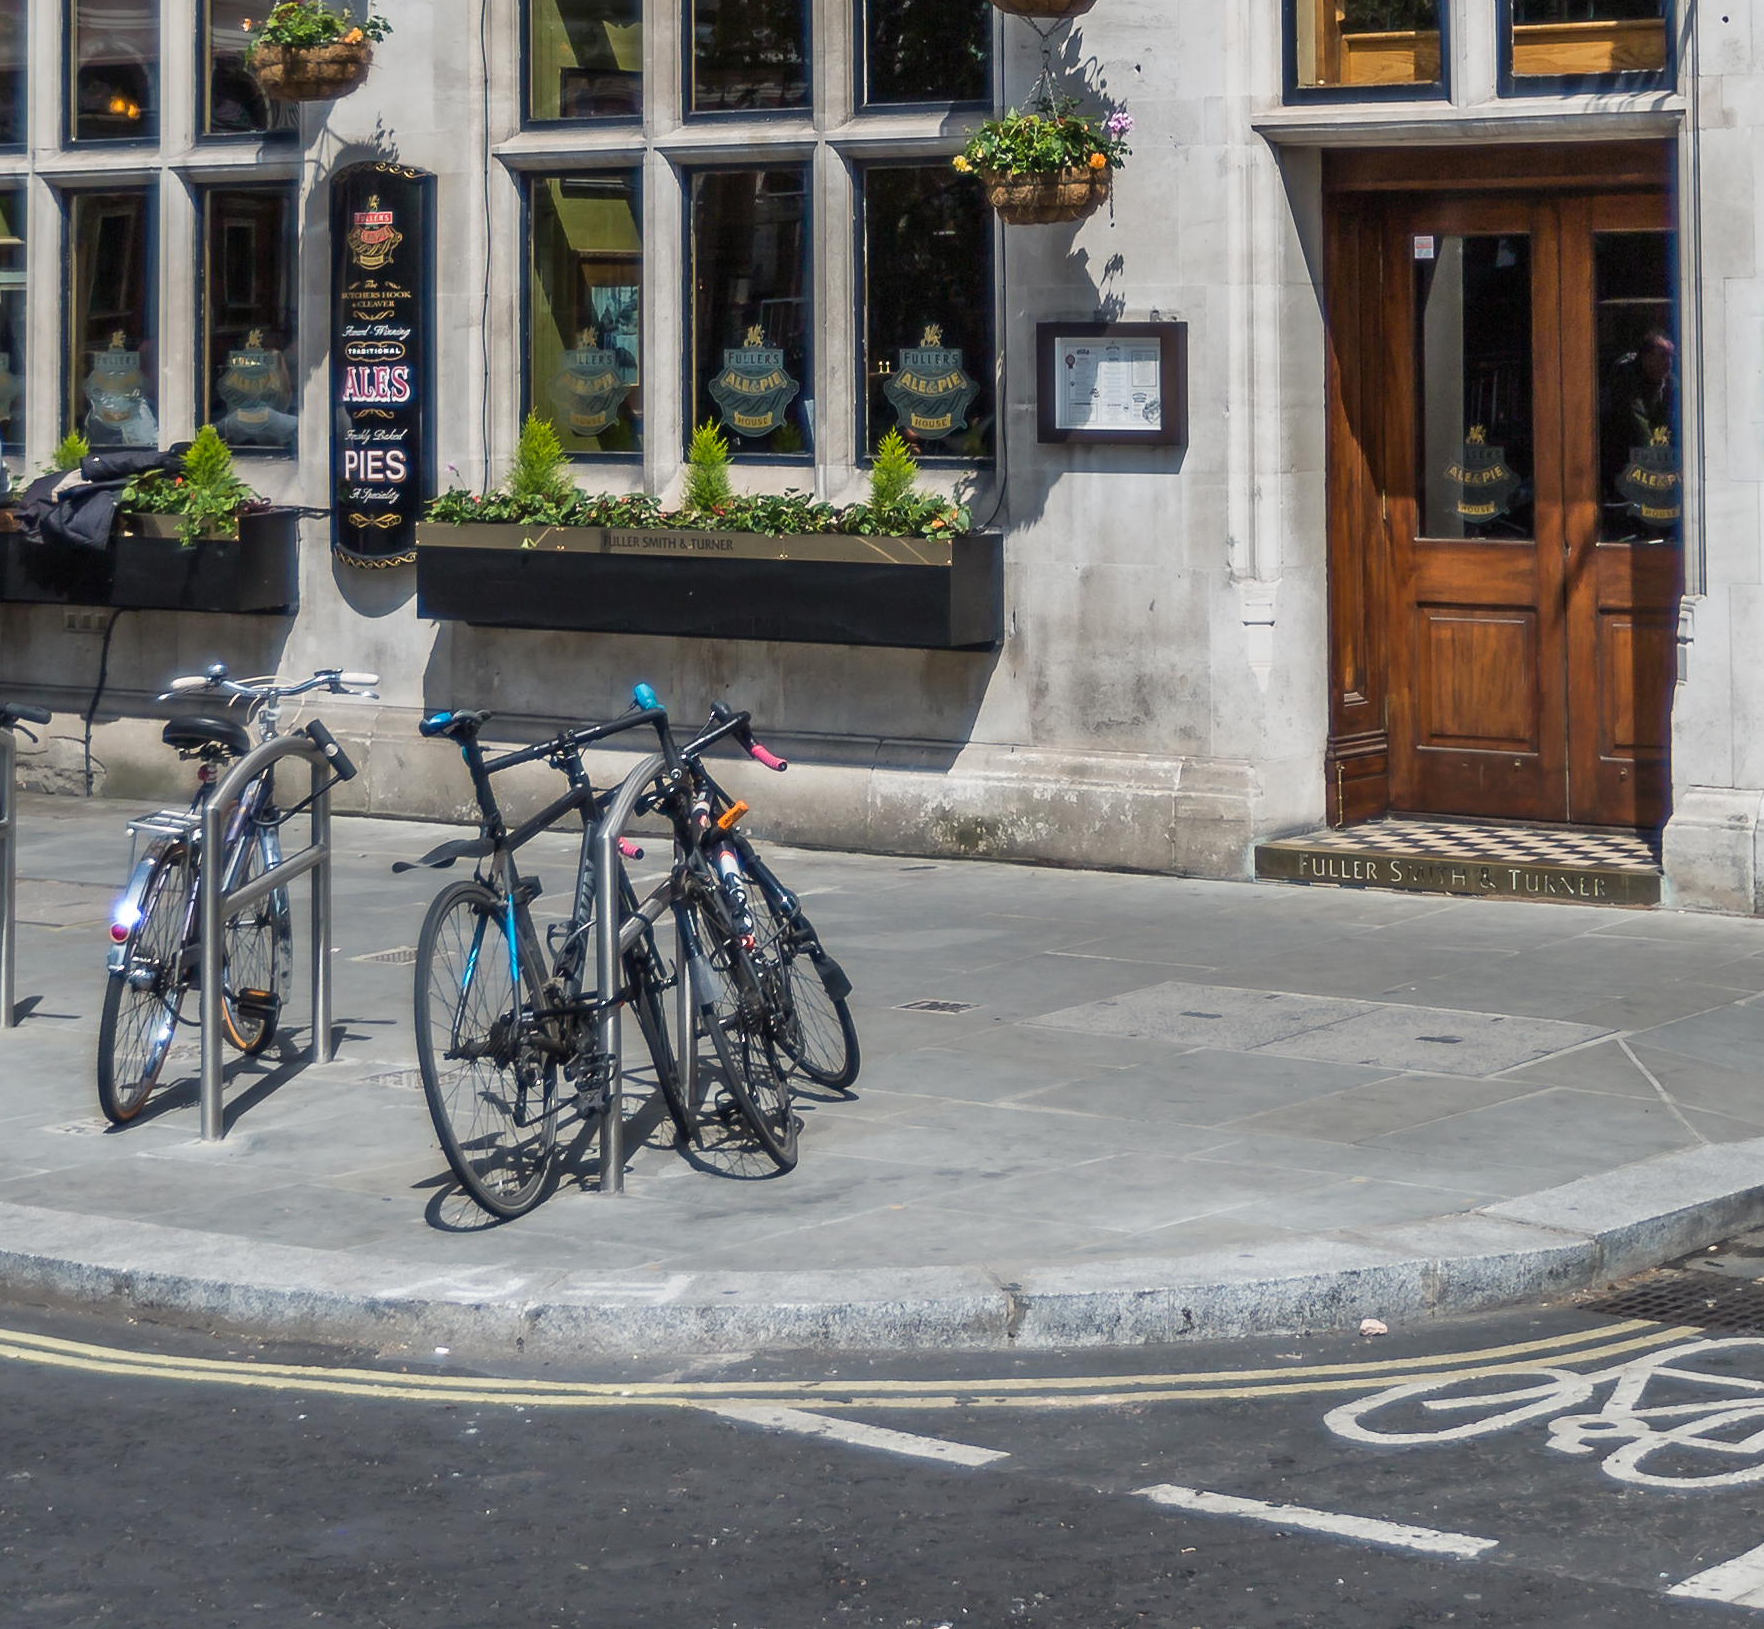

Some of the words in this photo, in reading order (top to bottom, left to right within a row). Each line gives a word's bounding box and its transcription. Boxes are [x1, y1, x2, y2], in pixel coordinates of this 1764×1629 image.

[342, 292, 380, 300] BUTCHERS
[382, 291, 412, 299] HOOK
[358, 300, 395, 308] CLEAVER
[904, 352, 958, 365] FULLER'S
[342, 366, 410, 403] ALES
[737, 417, 769, 427] HOUSE
[915, 418, 948, 428] HOUSE
[372, 428, 408, 440] Baked
[344, 450, 406, 483] PIES
[1460, 505, 1493, 514] HOUSE
[603, 535, 640, 548] FULLER
[642, 536, 677, 549] SMITH
[679, 538, 688, 550] &
[691, 538, 734, 551] TURNER
[1298, 853, 1379, 881] FULLER
[1389, 860, 1467, 887] SMITH
[1479, 866, 1497, 889] &
[1507, 869, 1607, 898] TURNER
